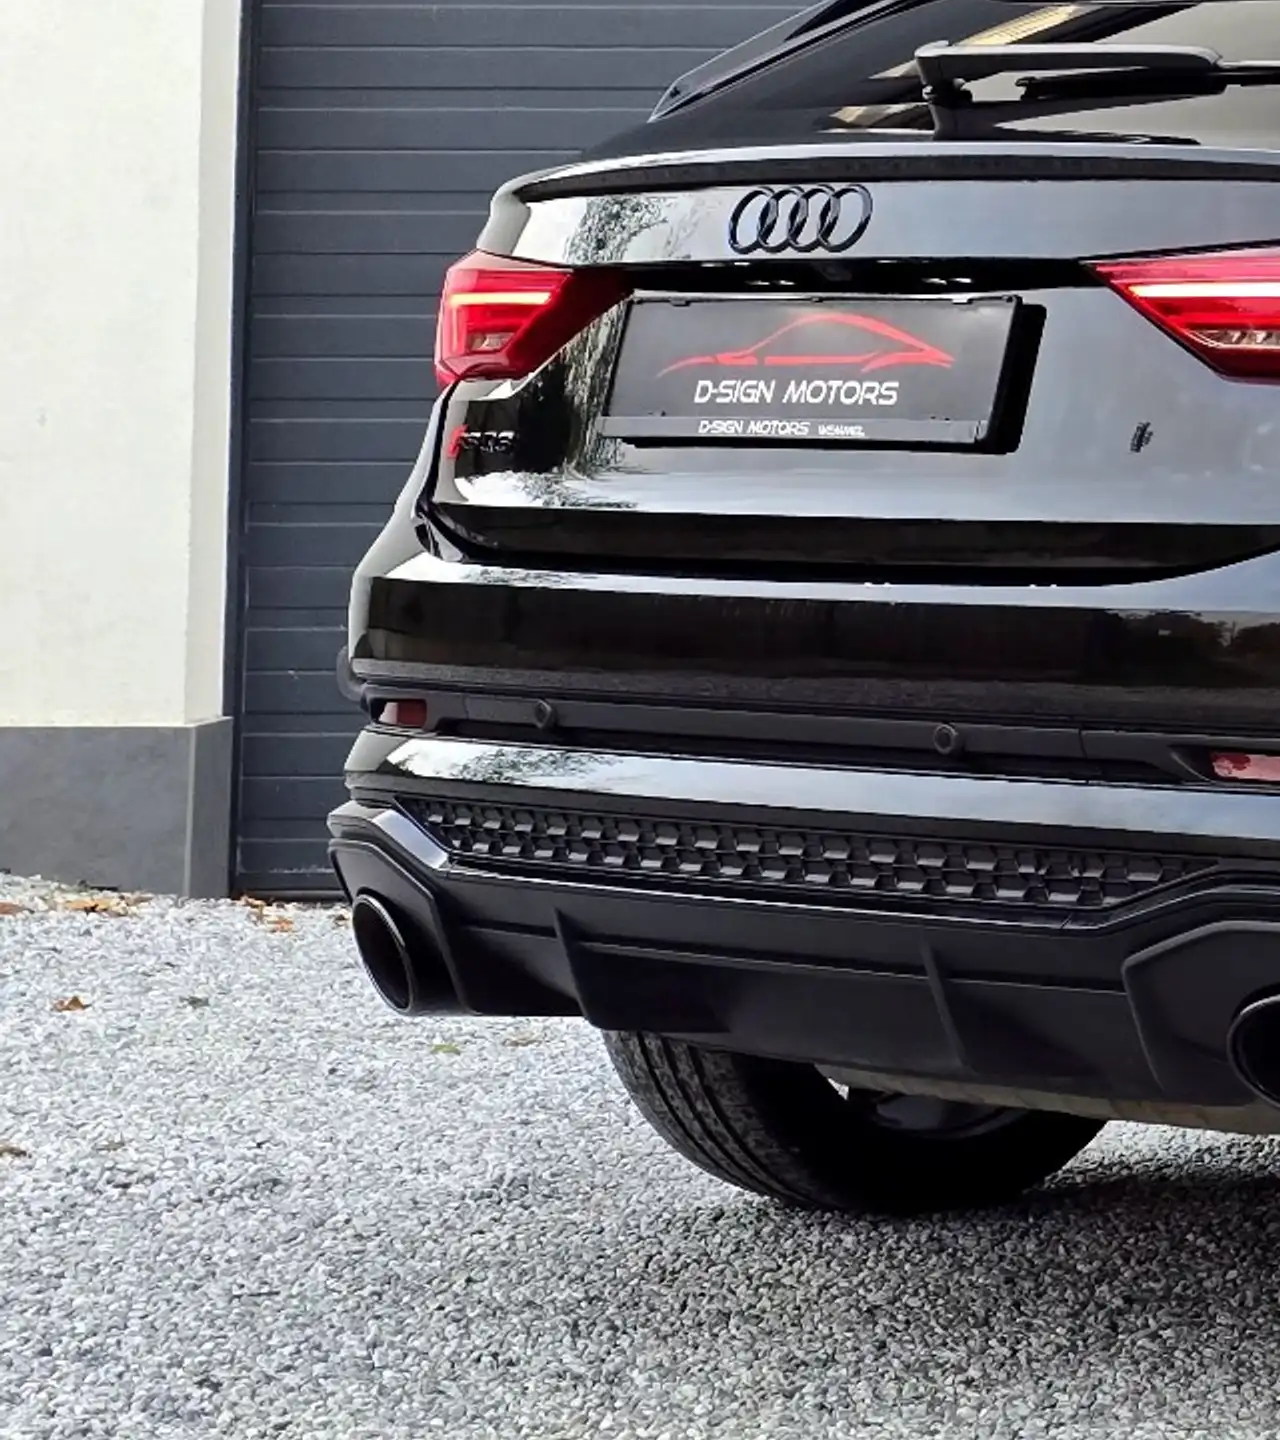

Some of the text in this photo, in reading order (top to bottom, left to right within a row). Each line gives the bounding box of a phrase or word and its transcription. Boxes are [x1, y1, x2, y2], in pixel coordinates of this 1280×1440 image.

[694, 379, 899, 406] D-SIGN MOTORS
[698, 420, 743, 434] D-SIGN
[747, 420, 811, 436] MOTORS
